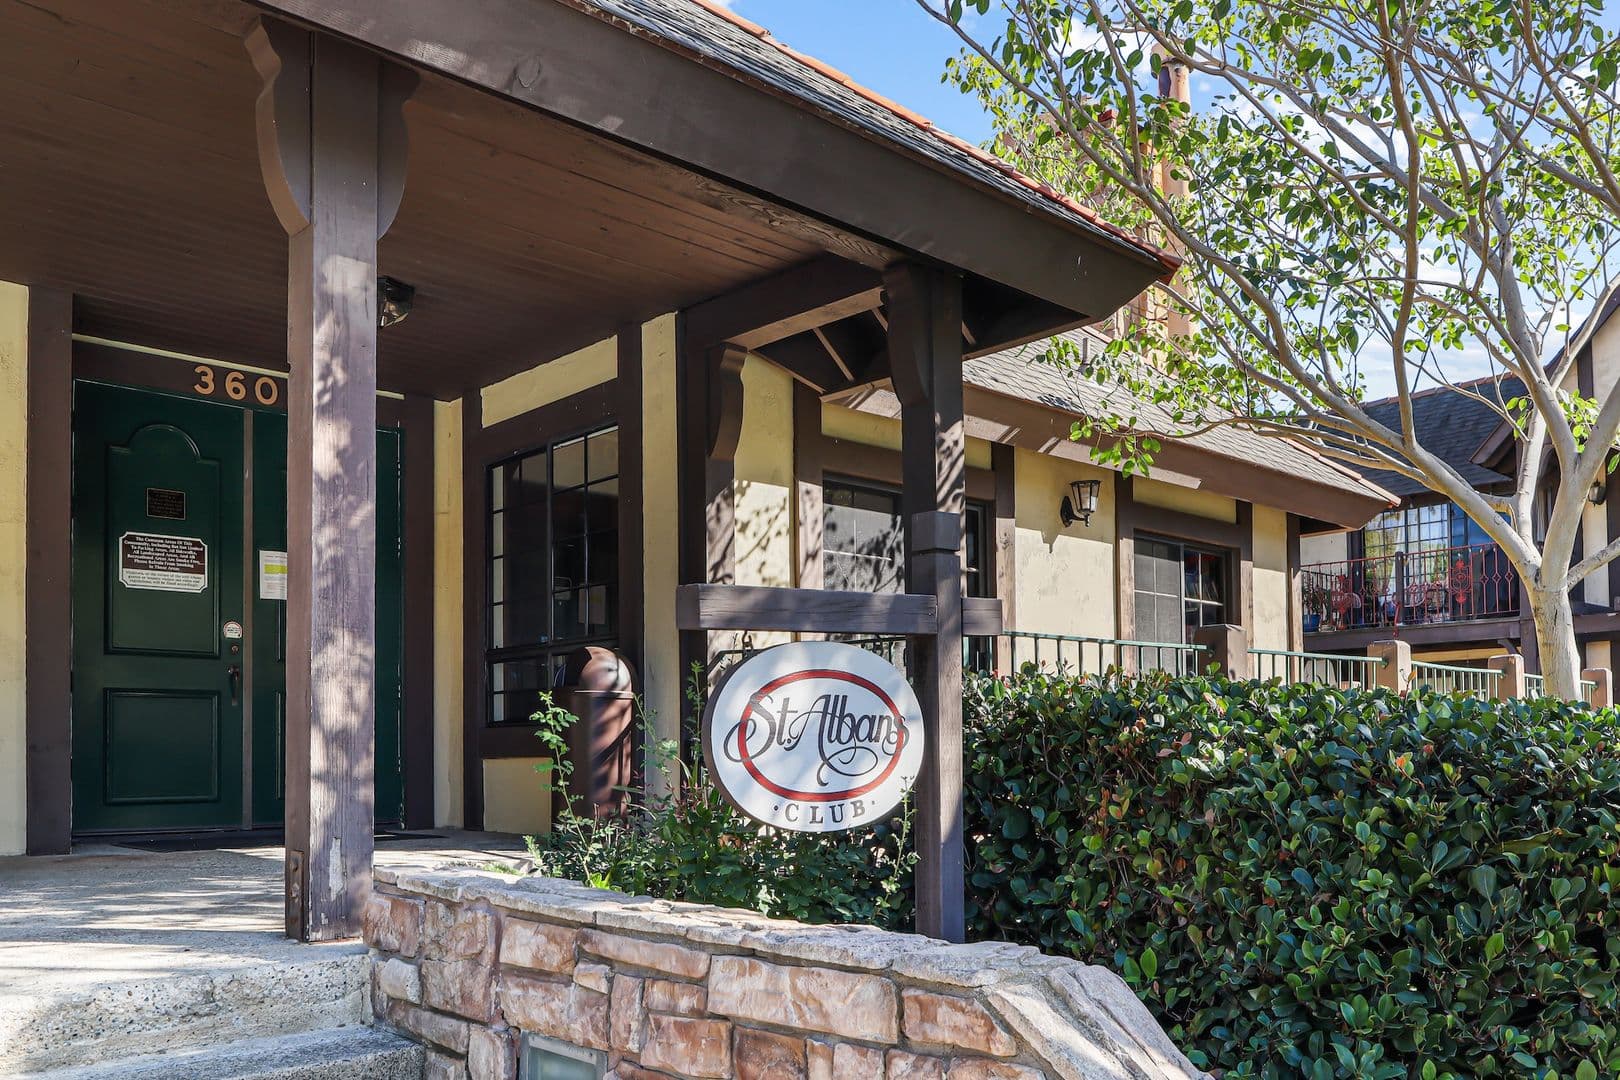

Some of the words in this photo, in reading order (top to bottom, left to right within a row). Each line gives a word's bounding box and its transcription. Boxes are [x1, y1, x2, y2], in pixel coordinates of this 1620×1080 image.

[194, 365, 278, 405] 360
[784, 694, 910, 787] Albans
[785, 799, 866, 824] CLUB
